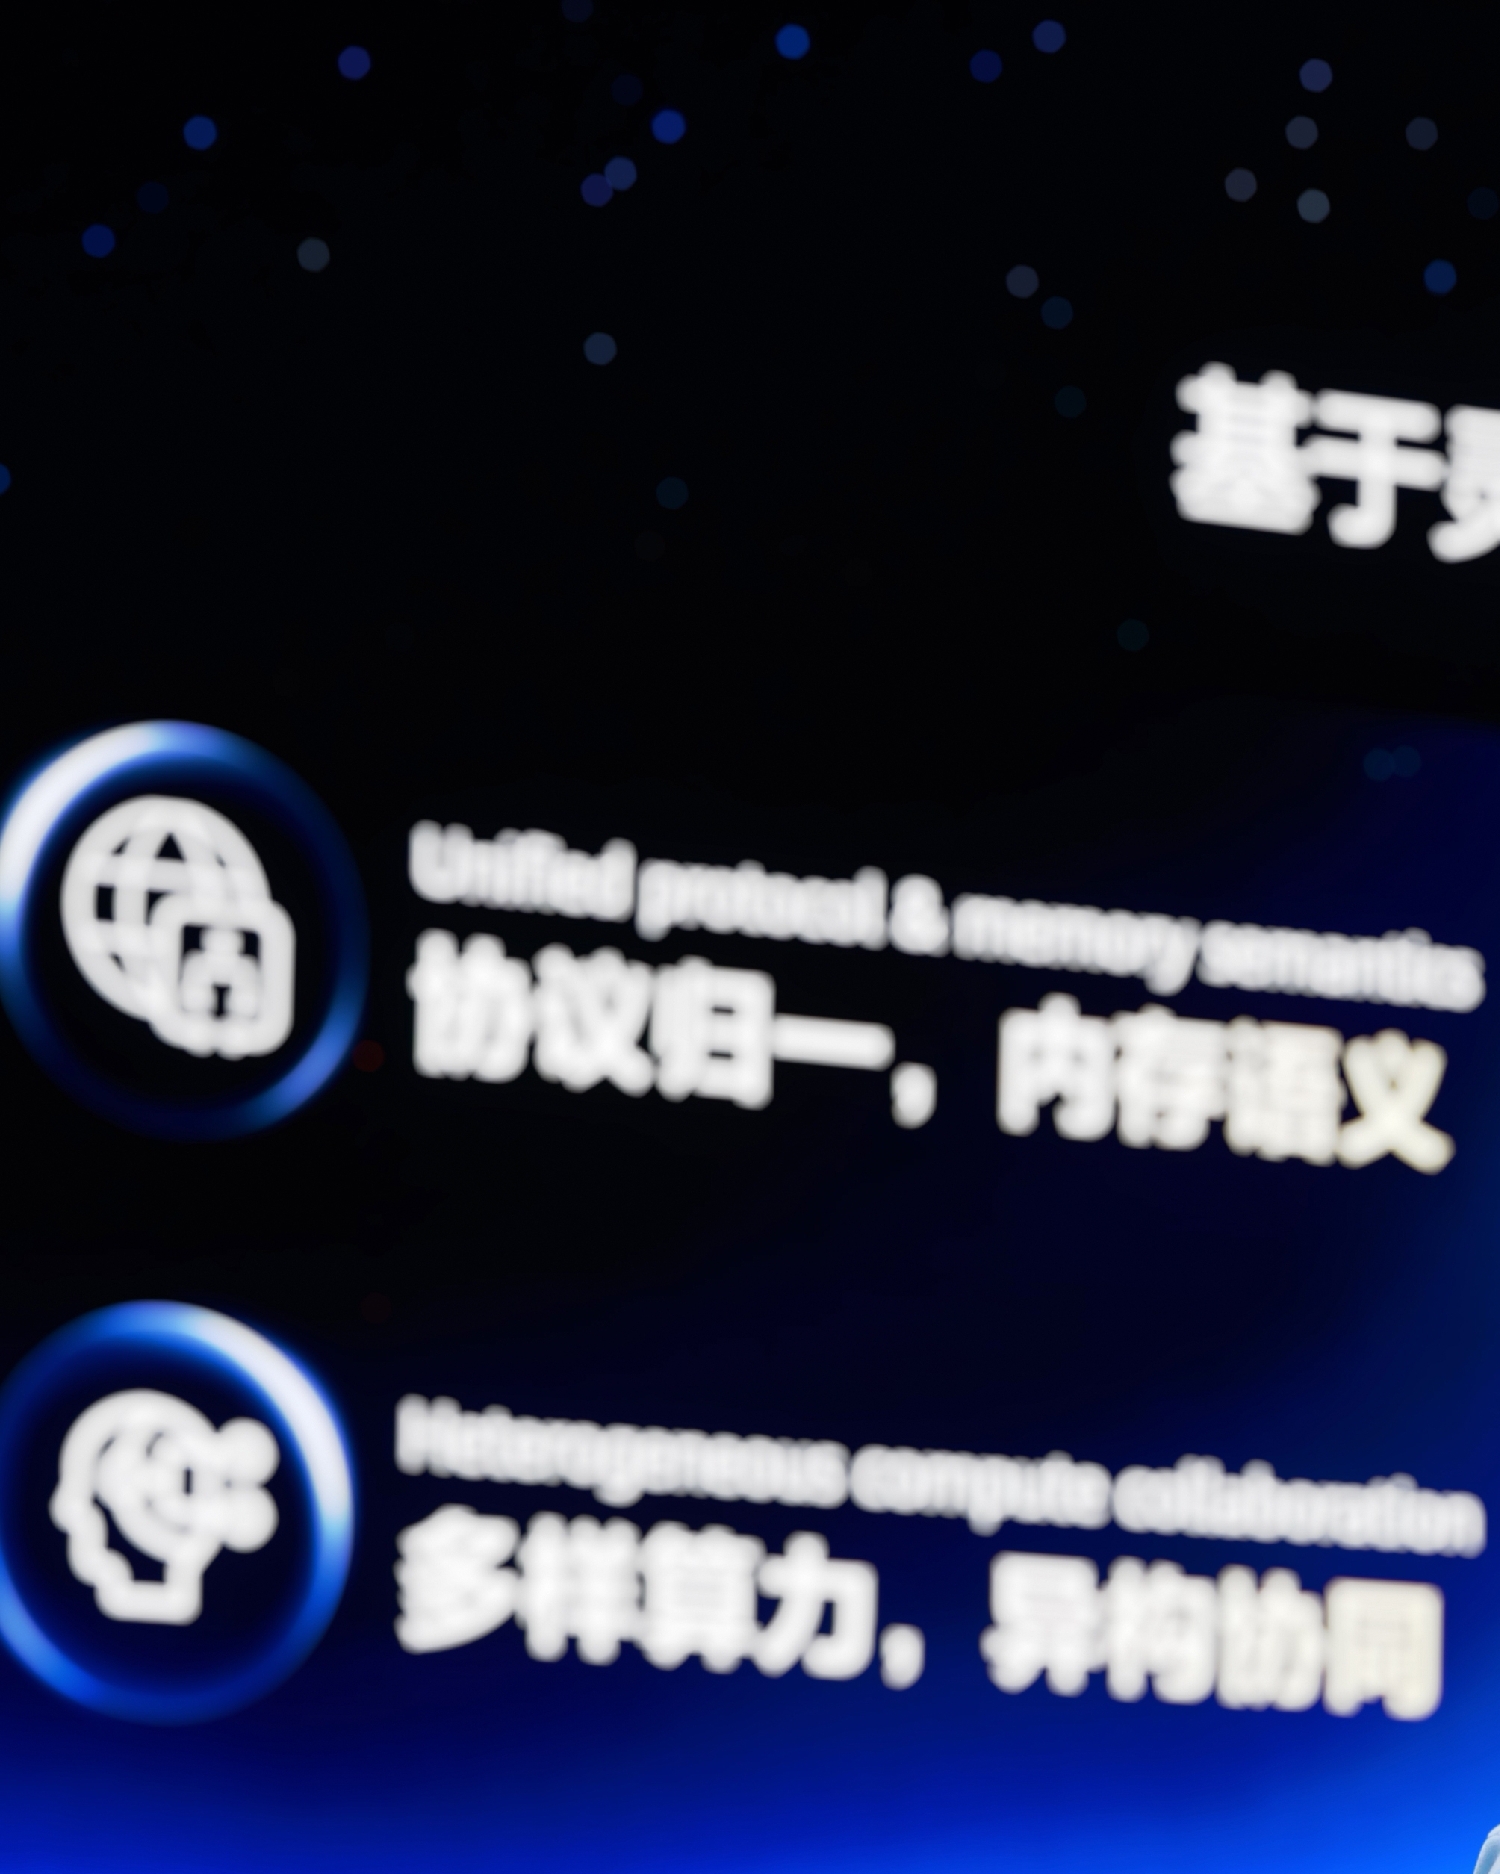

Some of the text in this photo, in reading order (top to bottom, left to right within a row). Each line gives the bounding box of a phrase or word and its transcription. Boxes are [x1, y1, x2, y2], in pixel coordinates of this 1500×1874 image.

[410, 824, 634, 919] Unified
[636, 859, 888, 941] protocol
[950, 896, 1200, 993] memory
